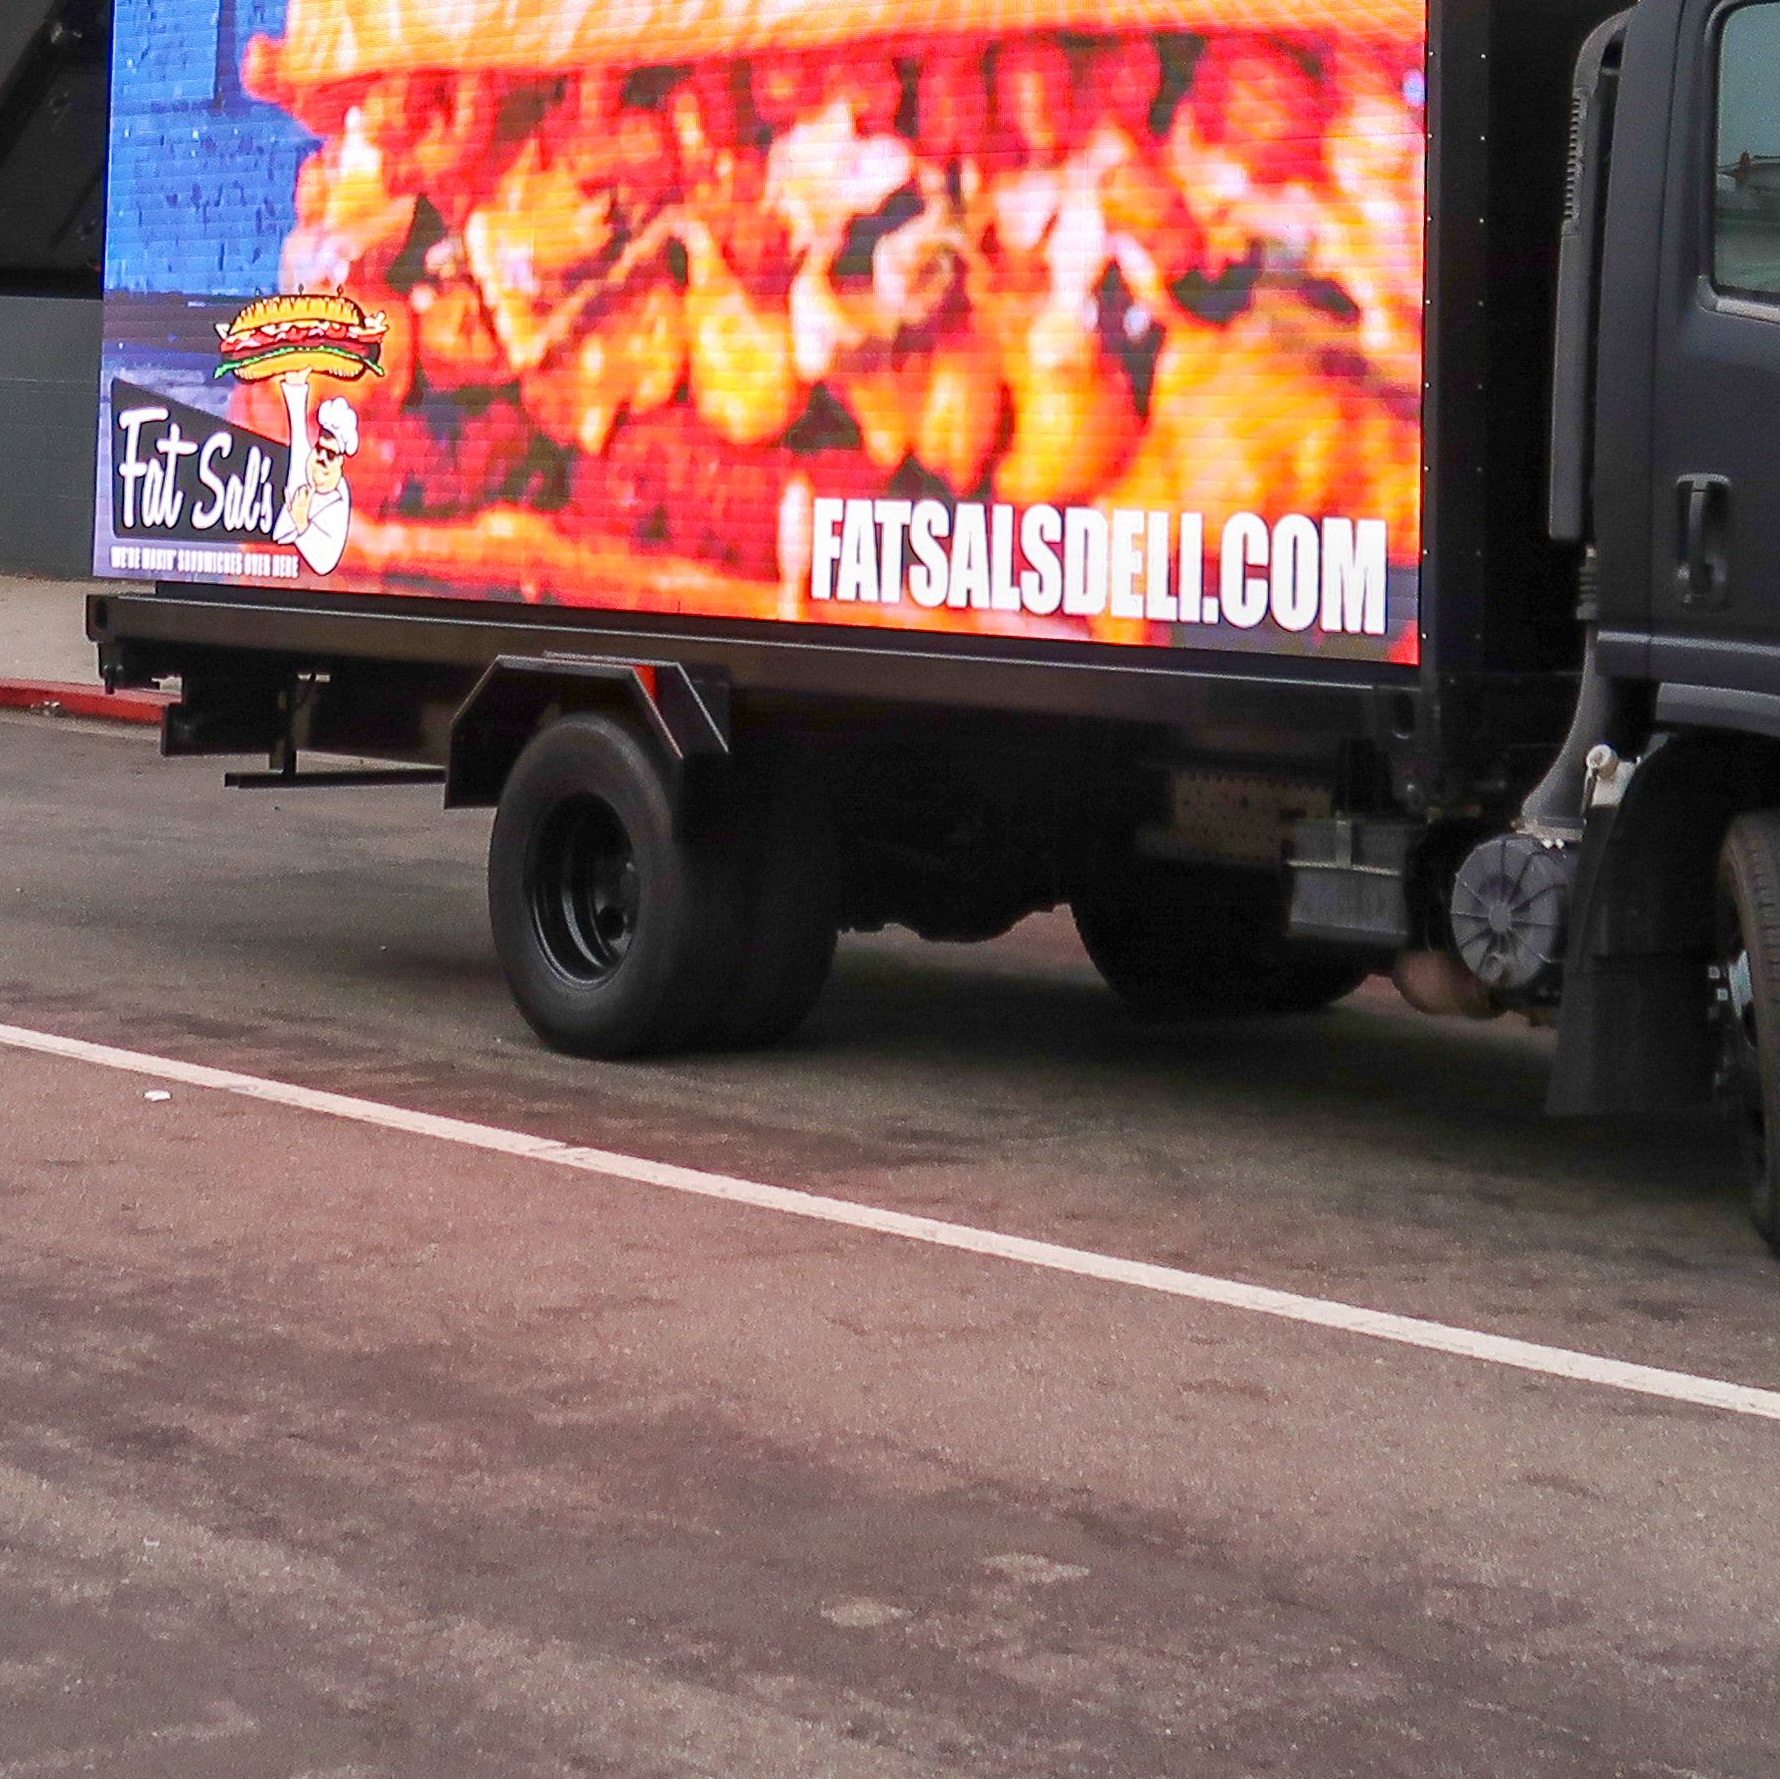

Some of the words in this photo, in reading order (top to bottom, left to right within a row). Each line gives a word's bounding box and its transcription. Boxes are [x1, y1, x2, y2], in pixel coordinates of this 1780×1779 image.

[119, 406, 198, 528] Fat
[191, 431, 274, 534] Sal's
[810, 497, 1388, 635] FATSALSDELI.COM
